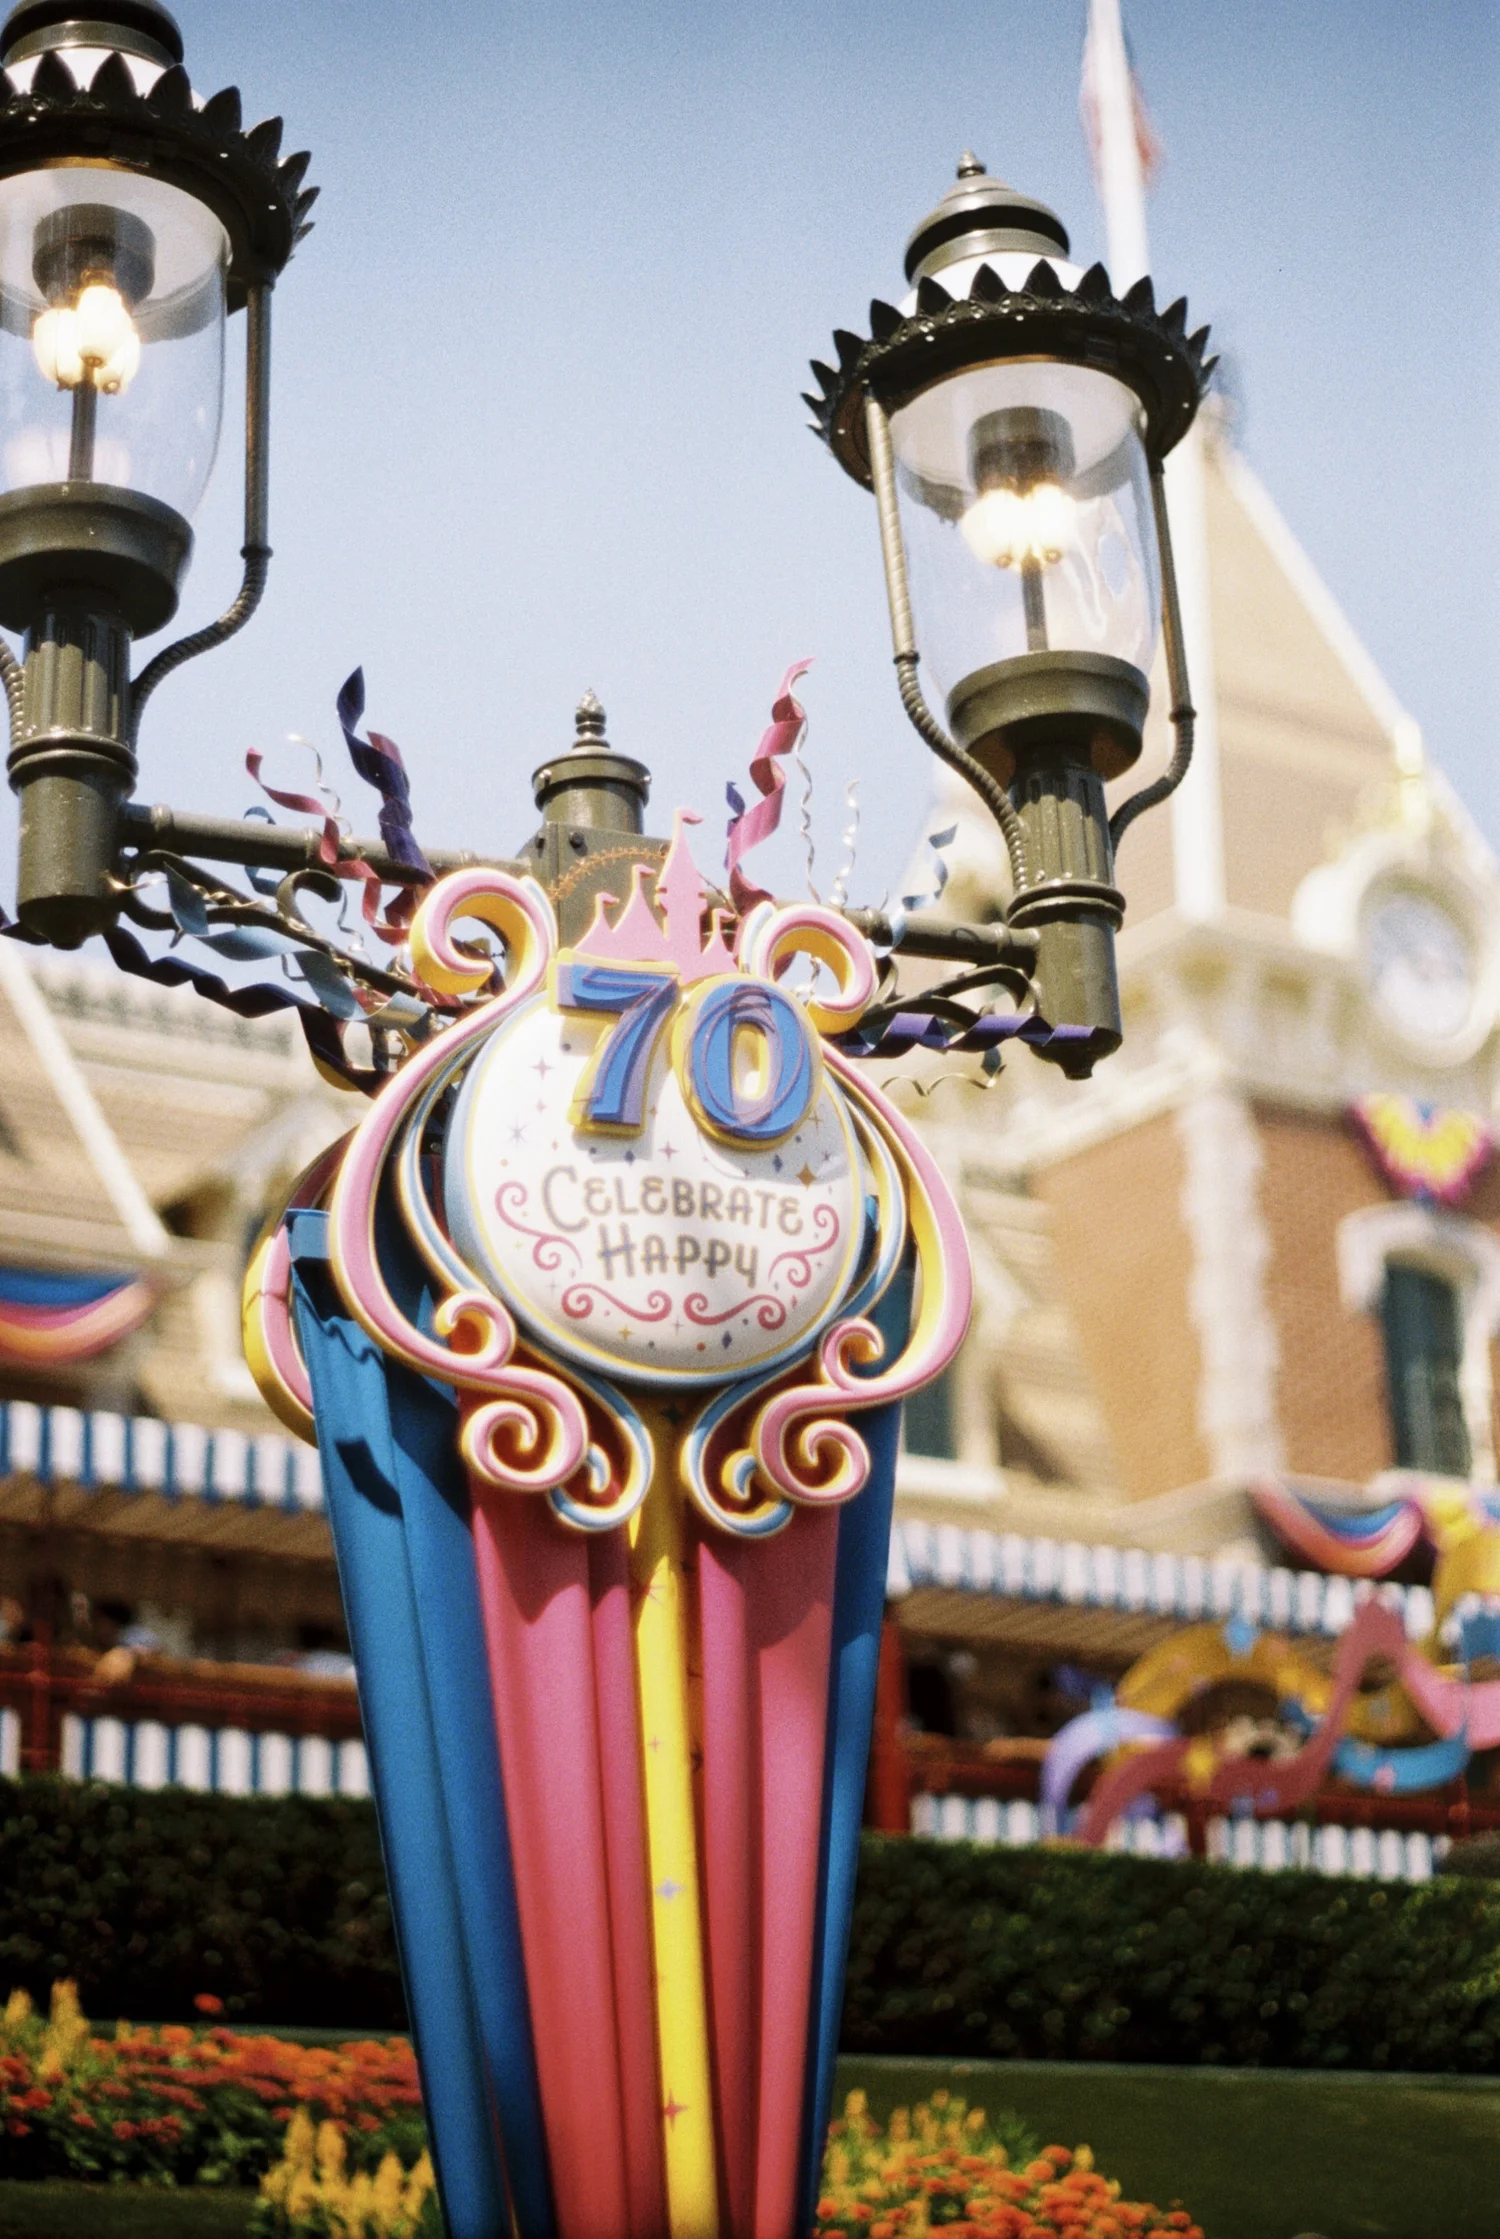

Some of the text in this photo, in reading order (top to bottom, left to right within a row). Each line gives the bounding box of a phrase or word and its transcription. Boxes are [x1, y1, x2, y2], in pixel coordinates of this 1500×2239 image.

[550, 950, 823, 1151] 70
[542, 1165, 804, 1236] CELEBRATE
[597, 1223, 760, 1288] HAPPY
